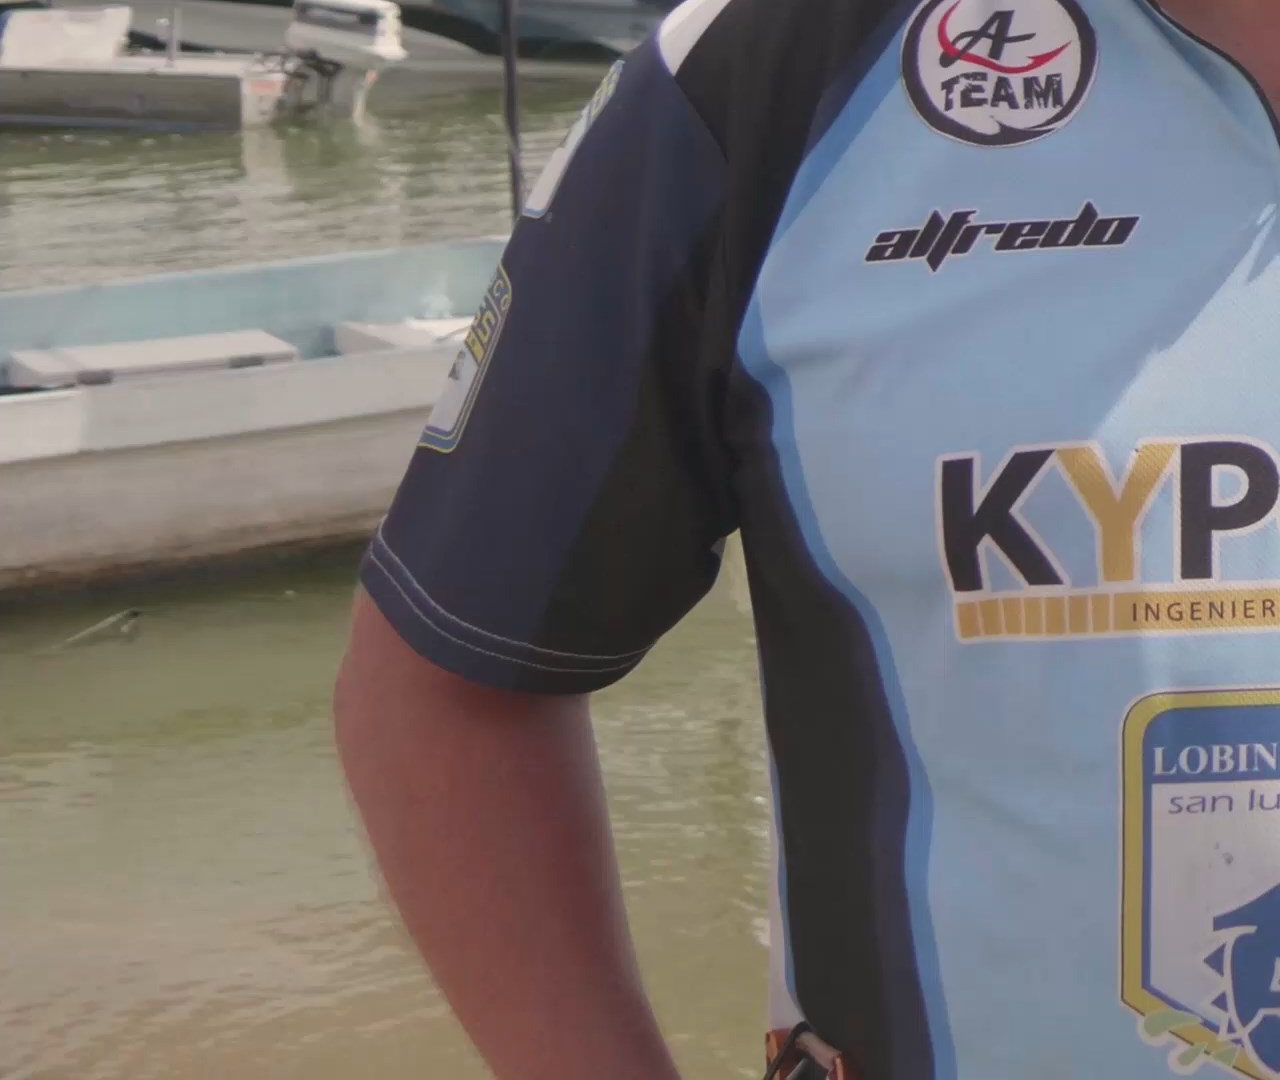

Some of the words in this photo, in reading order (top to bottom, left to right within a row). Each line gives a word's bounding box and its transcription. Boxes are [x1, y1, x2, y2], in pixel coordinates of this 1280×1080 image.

[938, 9, 1037, 69] A
[940, 71, 1065, 113] TEAM
[864, 199, 1141, 274] alfredo
[1167, 789, 1235, 815] san
